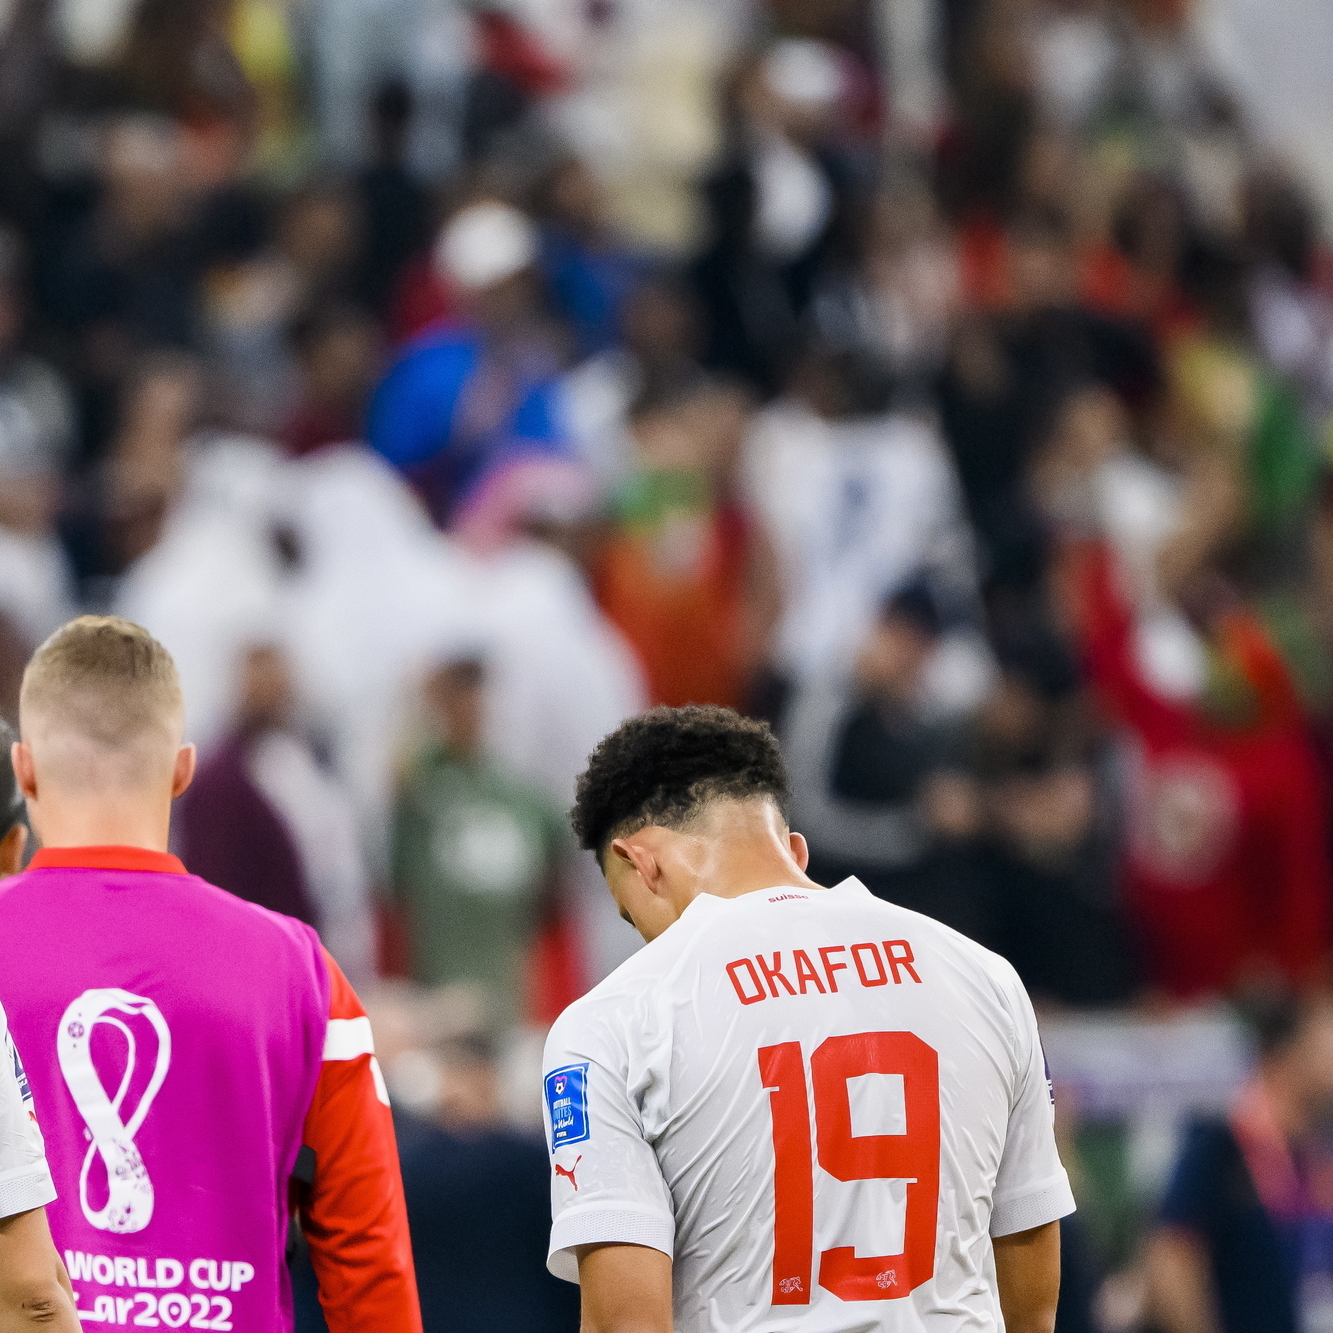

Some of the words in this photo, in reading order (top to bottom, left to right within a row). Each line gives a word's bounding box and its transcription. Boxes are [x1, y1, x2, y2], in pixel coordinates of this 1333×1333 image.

[725, 939, 923, 1006] OKAFOR
[756, 1030, 941, 1306] 19
[64, 1250, 184, 1289] WORLD
[189, 1258, 255, 1292] CUP
